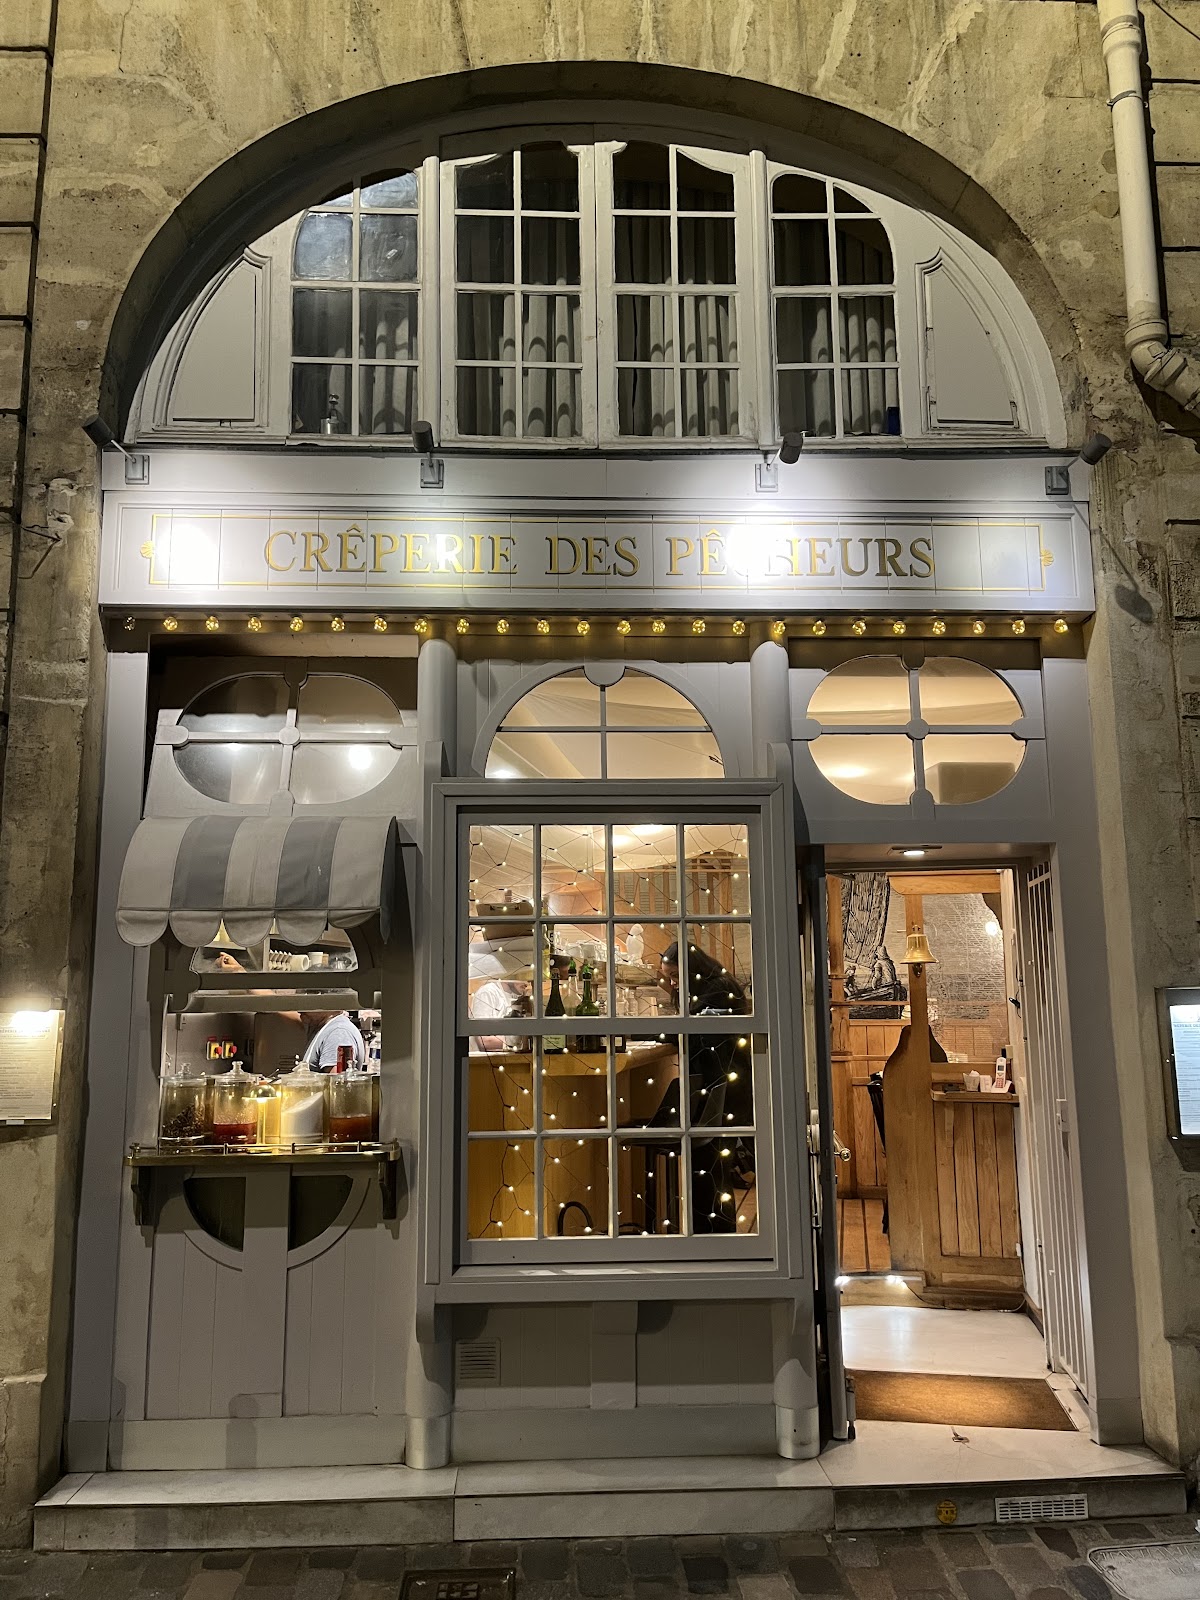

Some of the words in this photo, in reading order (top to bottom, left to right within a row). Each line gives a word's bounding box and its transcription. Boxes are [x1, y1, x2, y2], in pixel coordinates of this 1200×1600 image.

[264, 524, 518, 574] CRÊPERIE
[544, 535, 640, 577] DES
[665, 529, 936, 578] PÊHEURS
